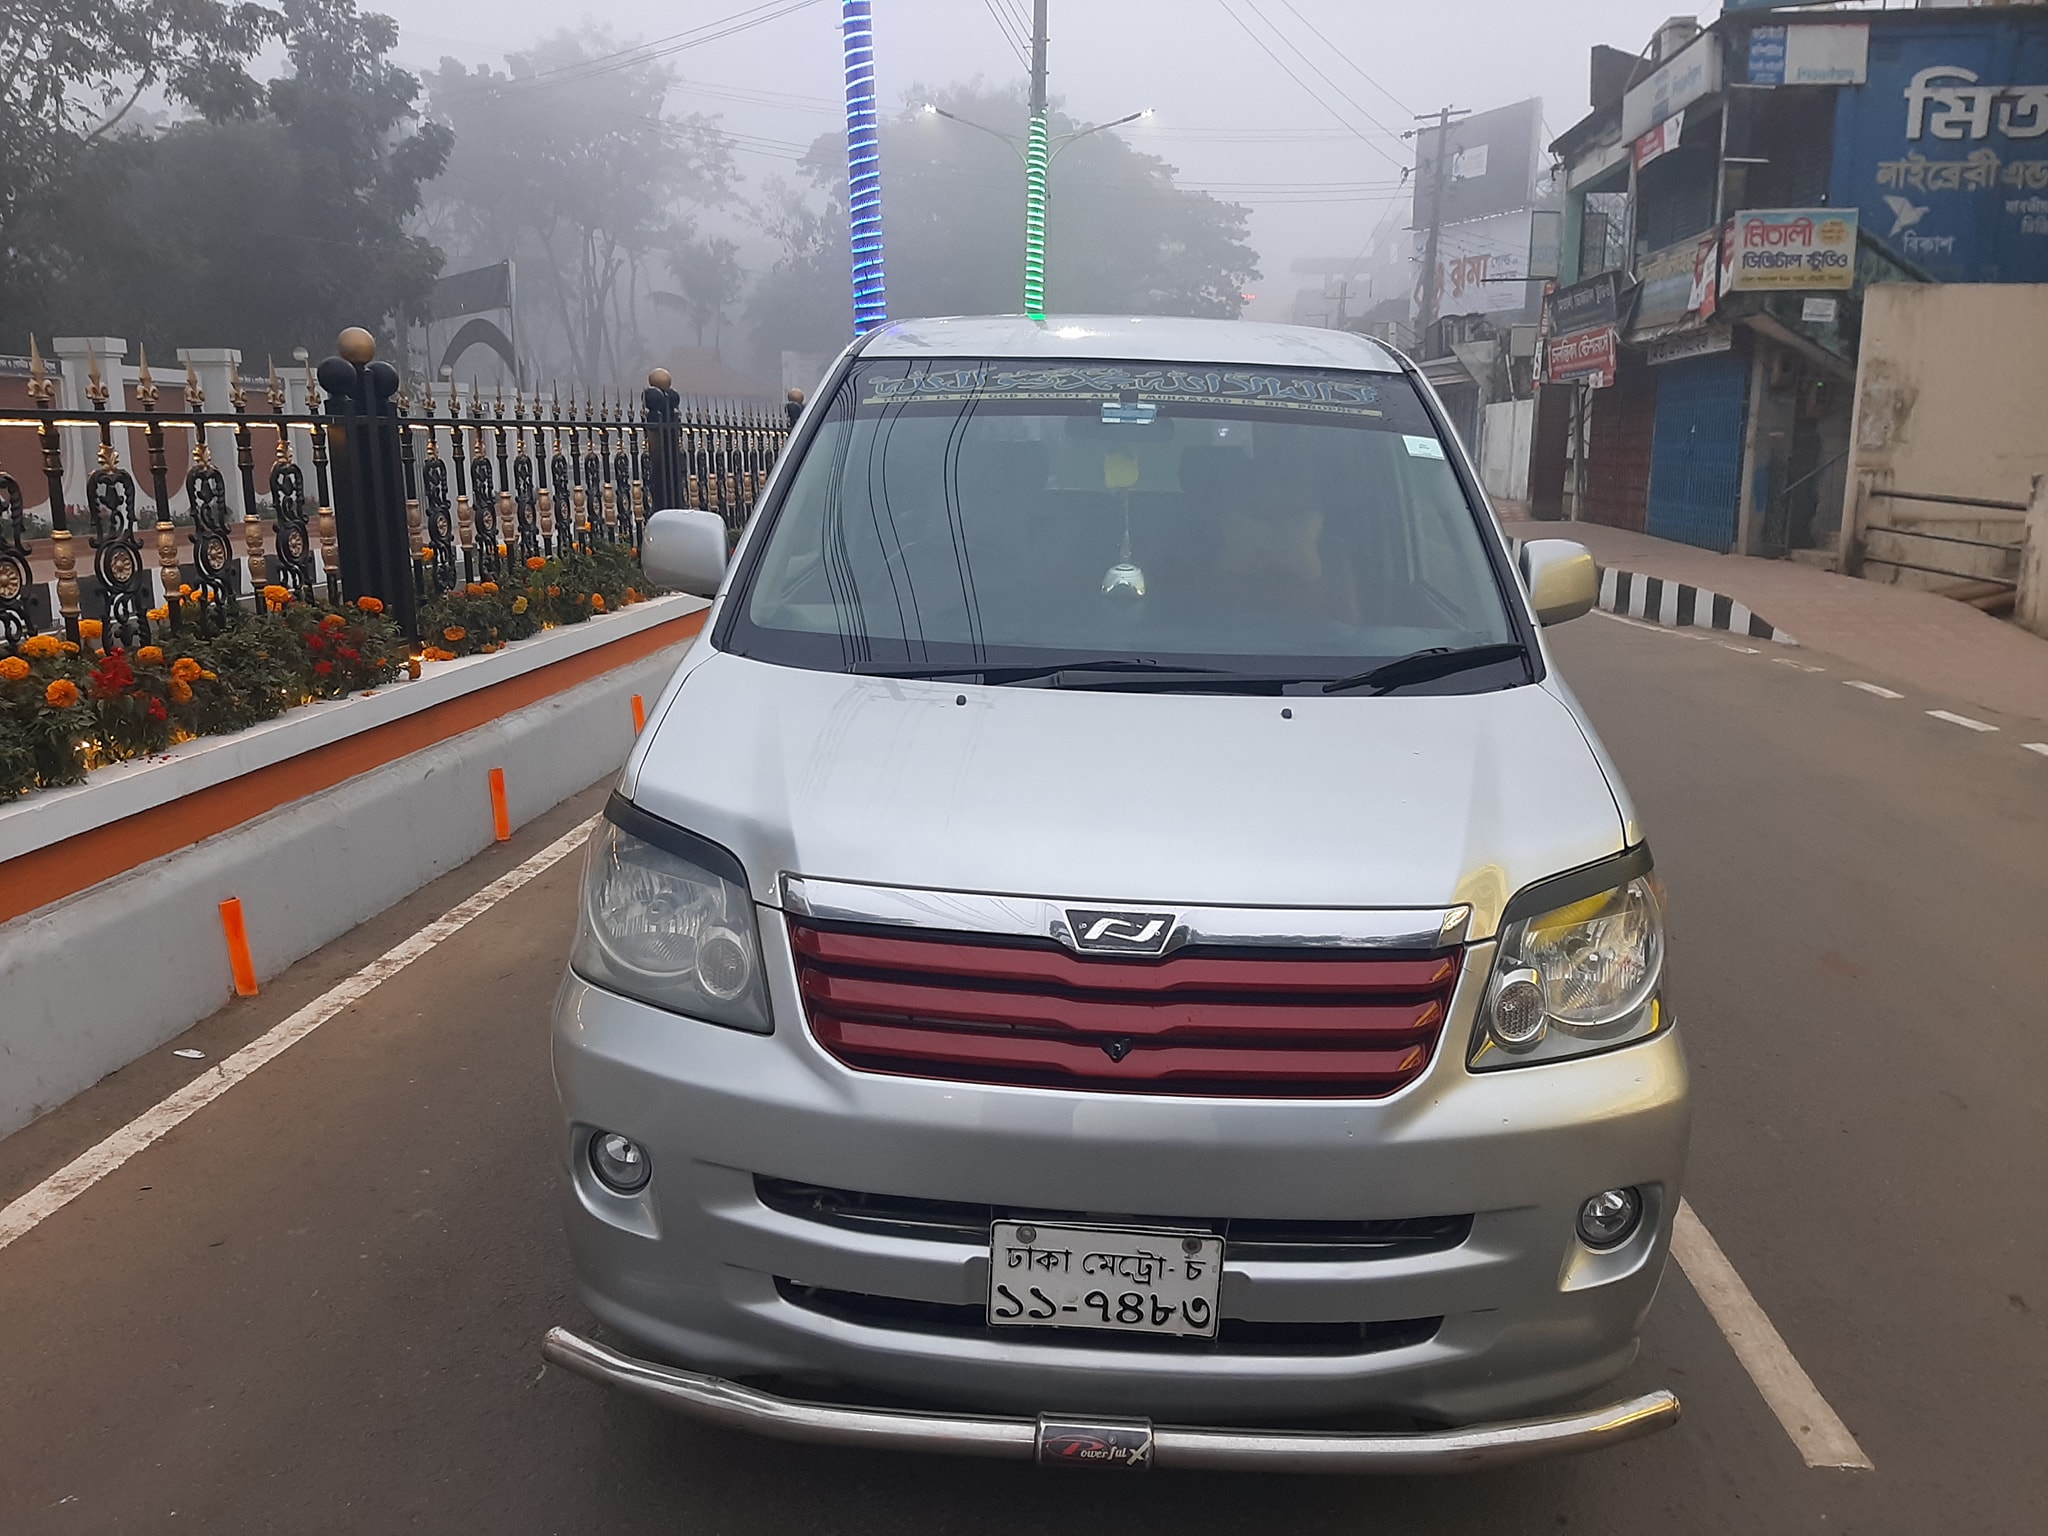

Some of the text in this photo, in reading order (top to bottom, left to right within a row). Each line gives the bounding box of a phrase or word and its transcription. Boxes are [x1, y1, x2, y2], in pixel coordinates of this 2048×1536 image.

[1145, 394, 1233, 404] MUHAMMAD
[1007, 1246, 1072, 1272] ঢাকা
[995, 1284, 1211, 1329] ১১-৭৪৮৩
